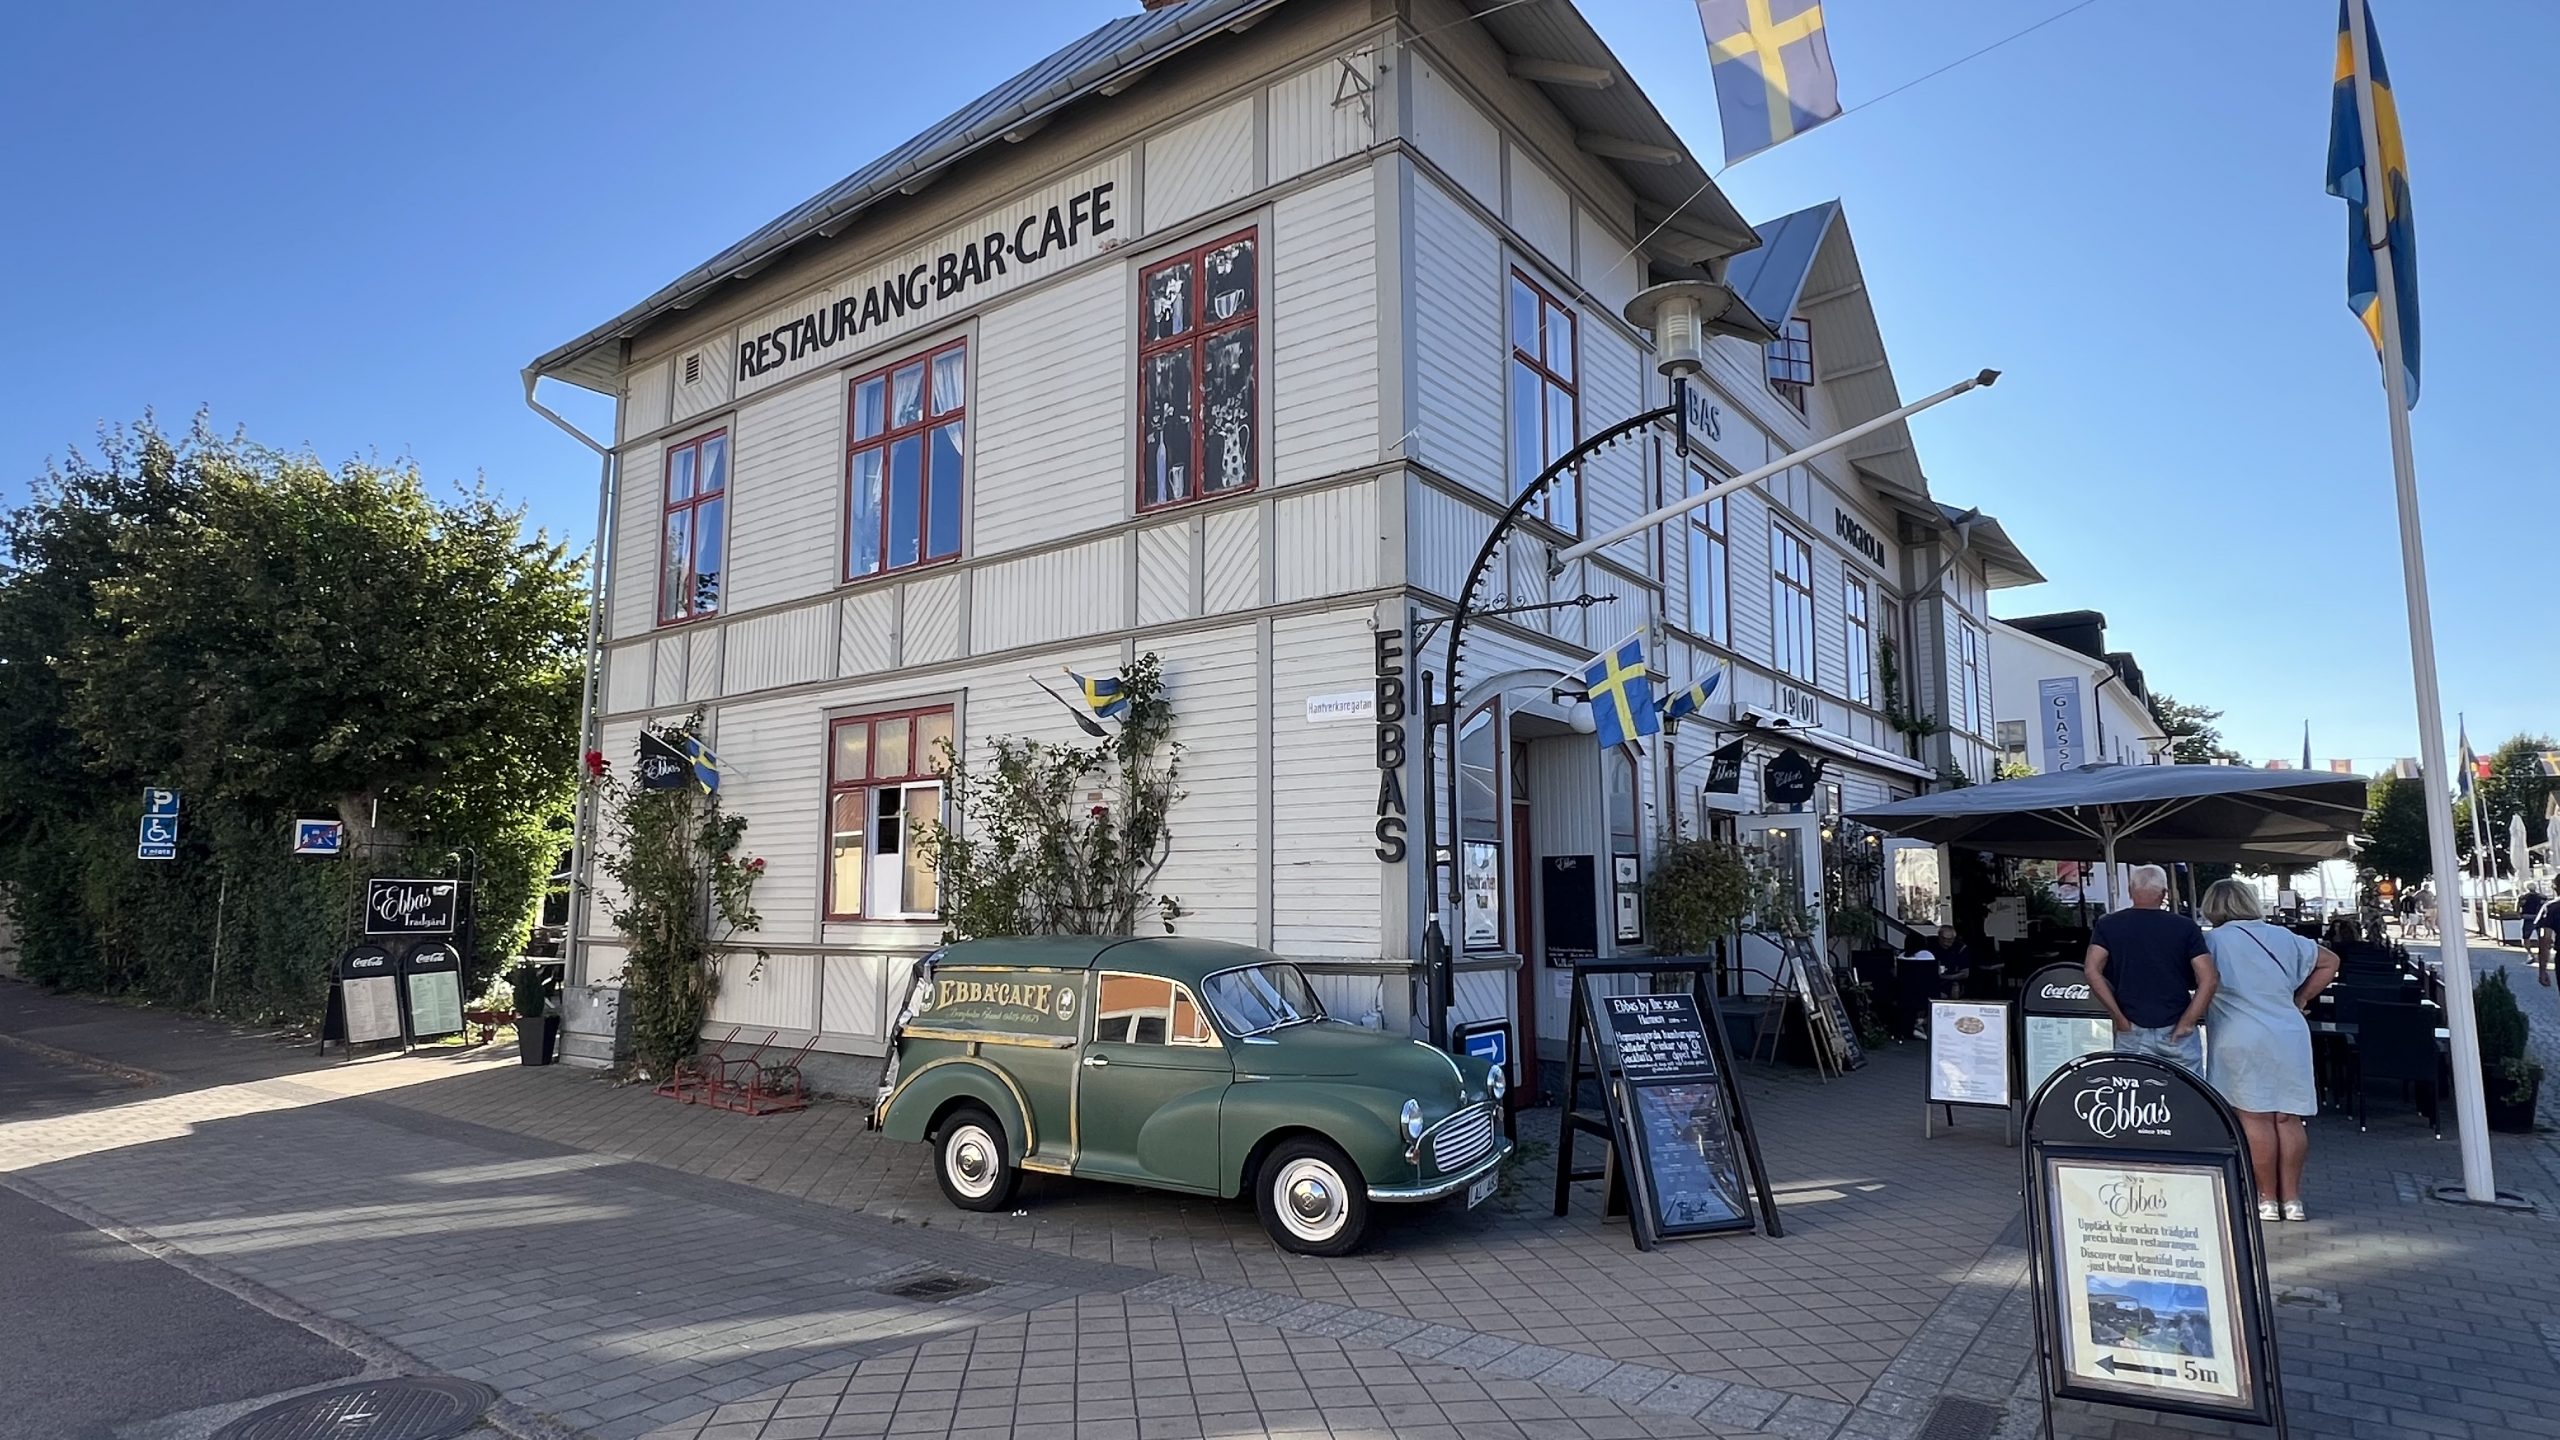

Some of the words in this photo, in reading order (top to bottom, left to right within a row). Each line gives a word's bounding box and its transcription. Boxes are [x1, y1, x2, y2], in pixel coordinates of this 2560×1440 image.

[1835, 507, 1885, 569] BORGHOLM
[1308, 700, 1372, 714] Hantverkaregatan
[1782, 686, 1816, 724] 1901
[1375, 629, 1407, 864] EBBAS
[152, 790, 173, 813] P
[372, 885, 432, 922] Ebbas
[352, 956, 385, 968] Coca-Cola
[415, 952, 446, 964] Coca-Cola
[998, 983, 1052, 1015] CAFE
[2040, 983, 2091, 1000] Coca-Cola
[2111, 1076, 2140, 1090] Nya
[2074, 1086, 2171, 1138] Ebbas
[2098, 1182, 2167, 1219] Ebbas
[2078, 1218, 2112, 1232] Upptäck
[2130, 1223, 2159, 1236] vackra
[2161, 1225, 2199, 1239] trädgård
[2110, 1232, 2138, 1246] bakom
[2080, 1247, 2116, 1260] Discover
[2118, 1252, 2133, 1262] our
[2135, 1252, 2173, 1266] beautiful
[2175, 1257, 2205, 1269] garden
[2107, 1261, 2136, 1274] behind
[2138, 1263, 2151, 1276] the
[2184, 1360, 2219, 1384] 5m
